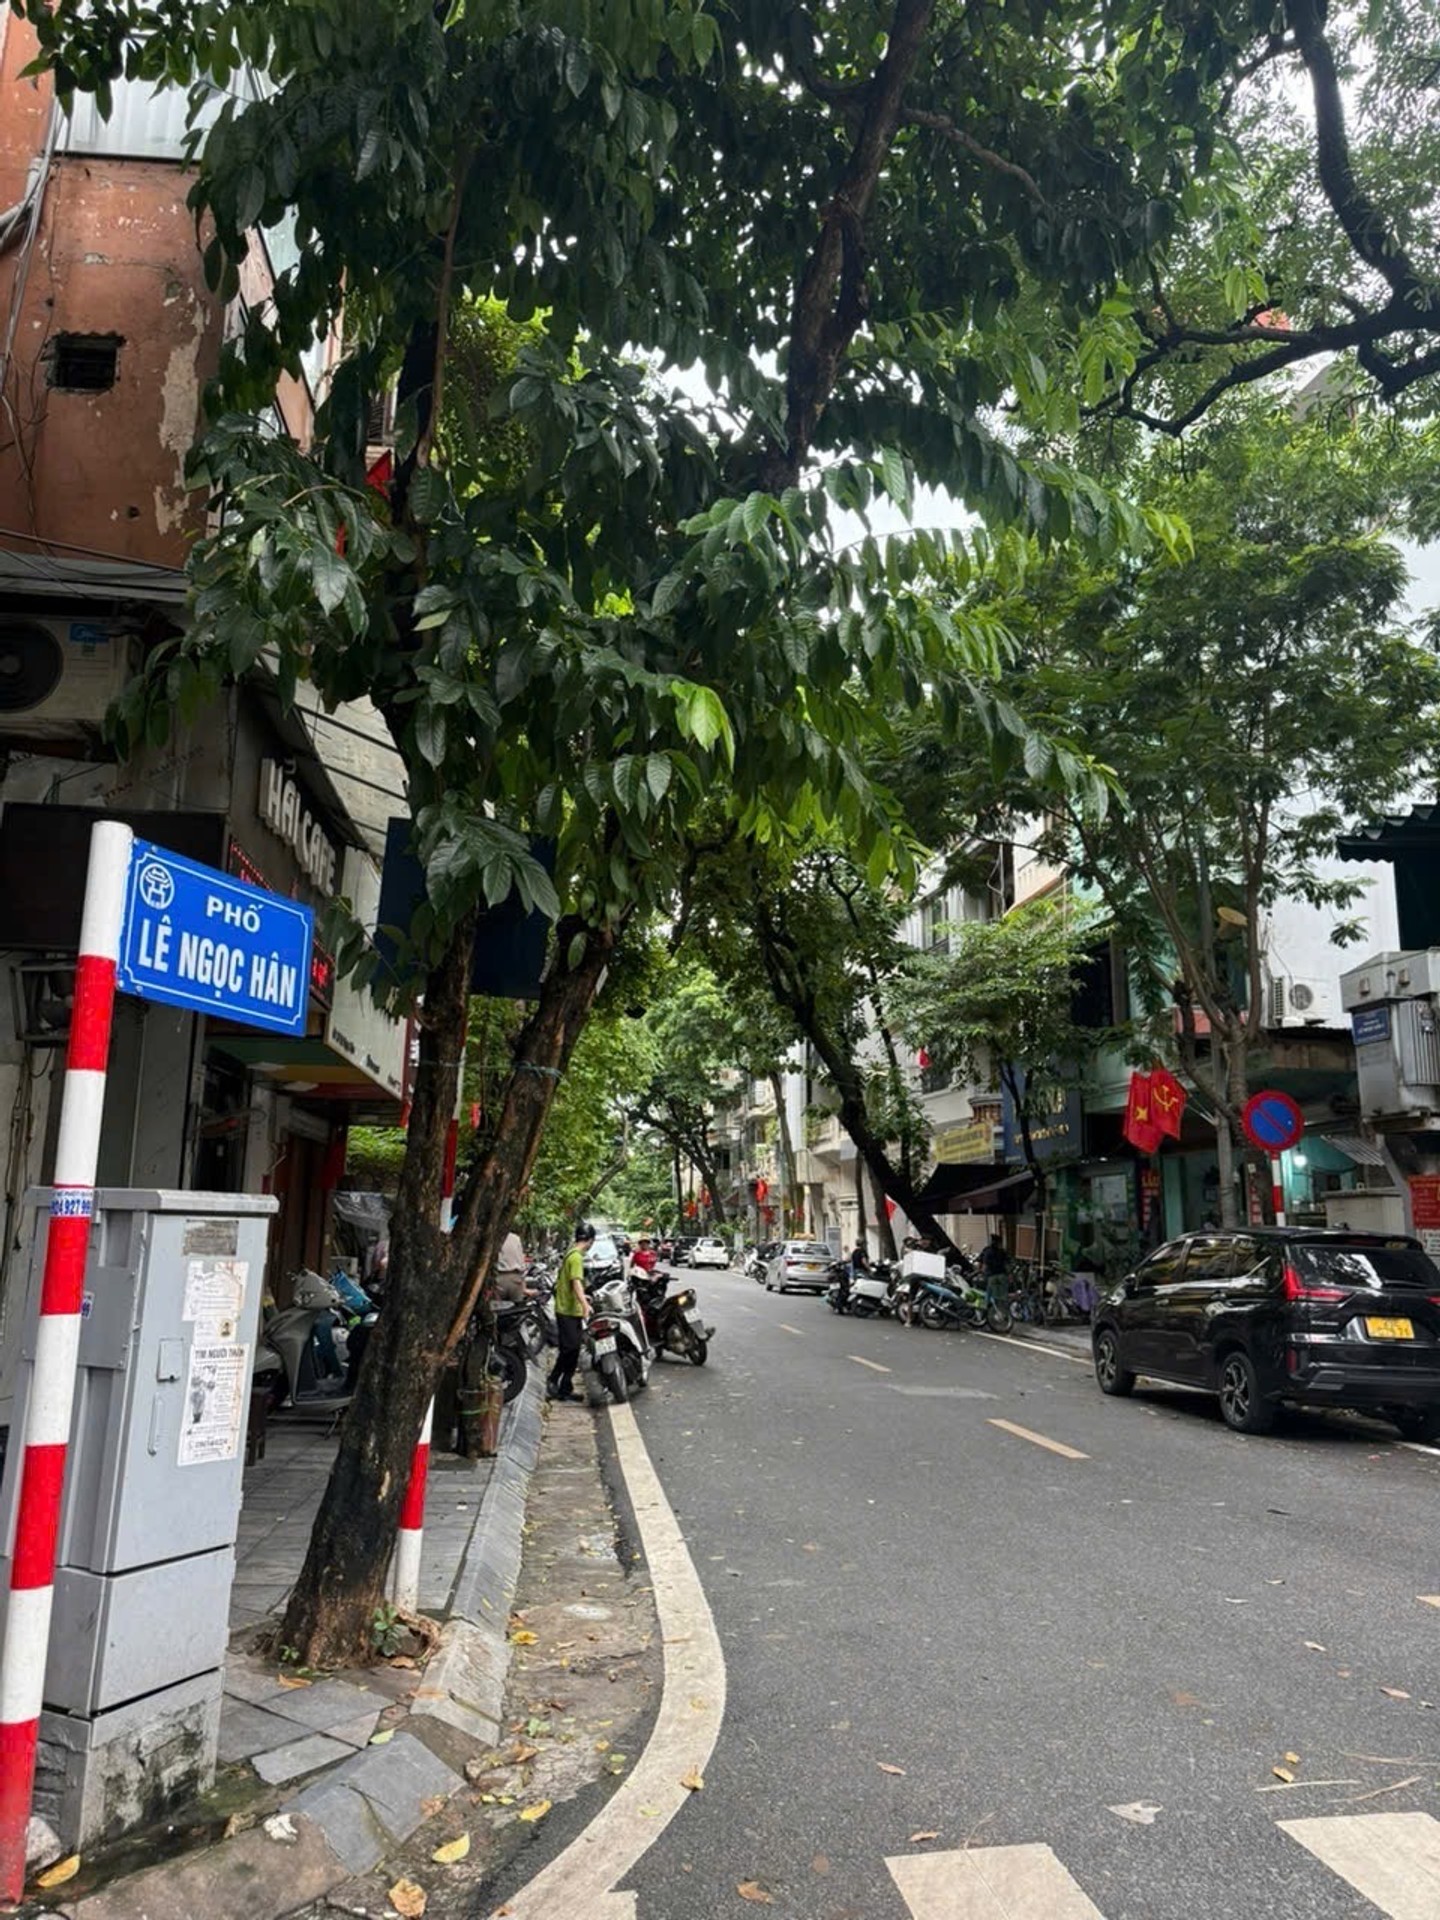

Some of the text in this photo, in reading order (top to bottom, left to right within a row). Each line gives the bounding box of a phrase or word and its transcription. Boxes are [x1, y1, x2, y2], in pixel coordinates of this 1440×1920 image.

[206, 895, 264, 933] PHỐ
[138, 914, 173, 973] LÊ
[178, 931, 245, 999] NGỌC
[250, 951, 297, 1008] HÂN
